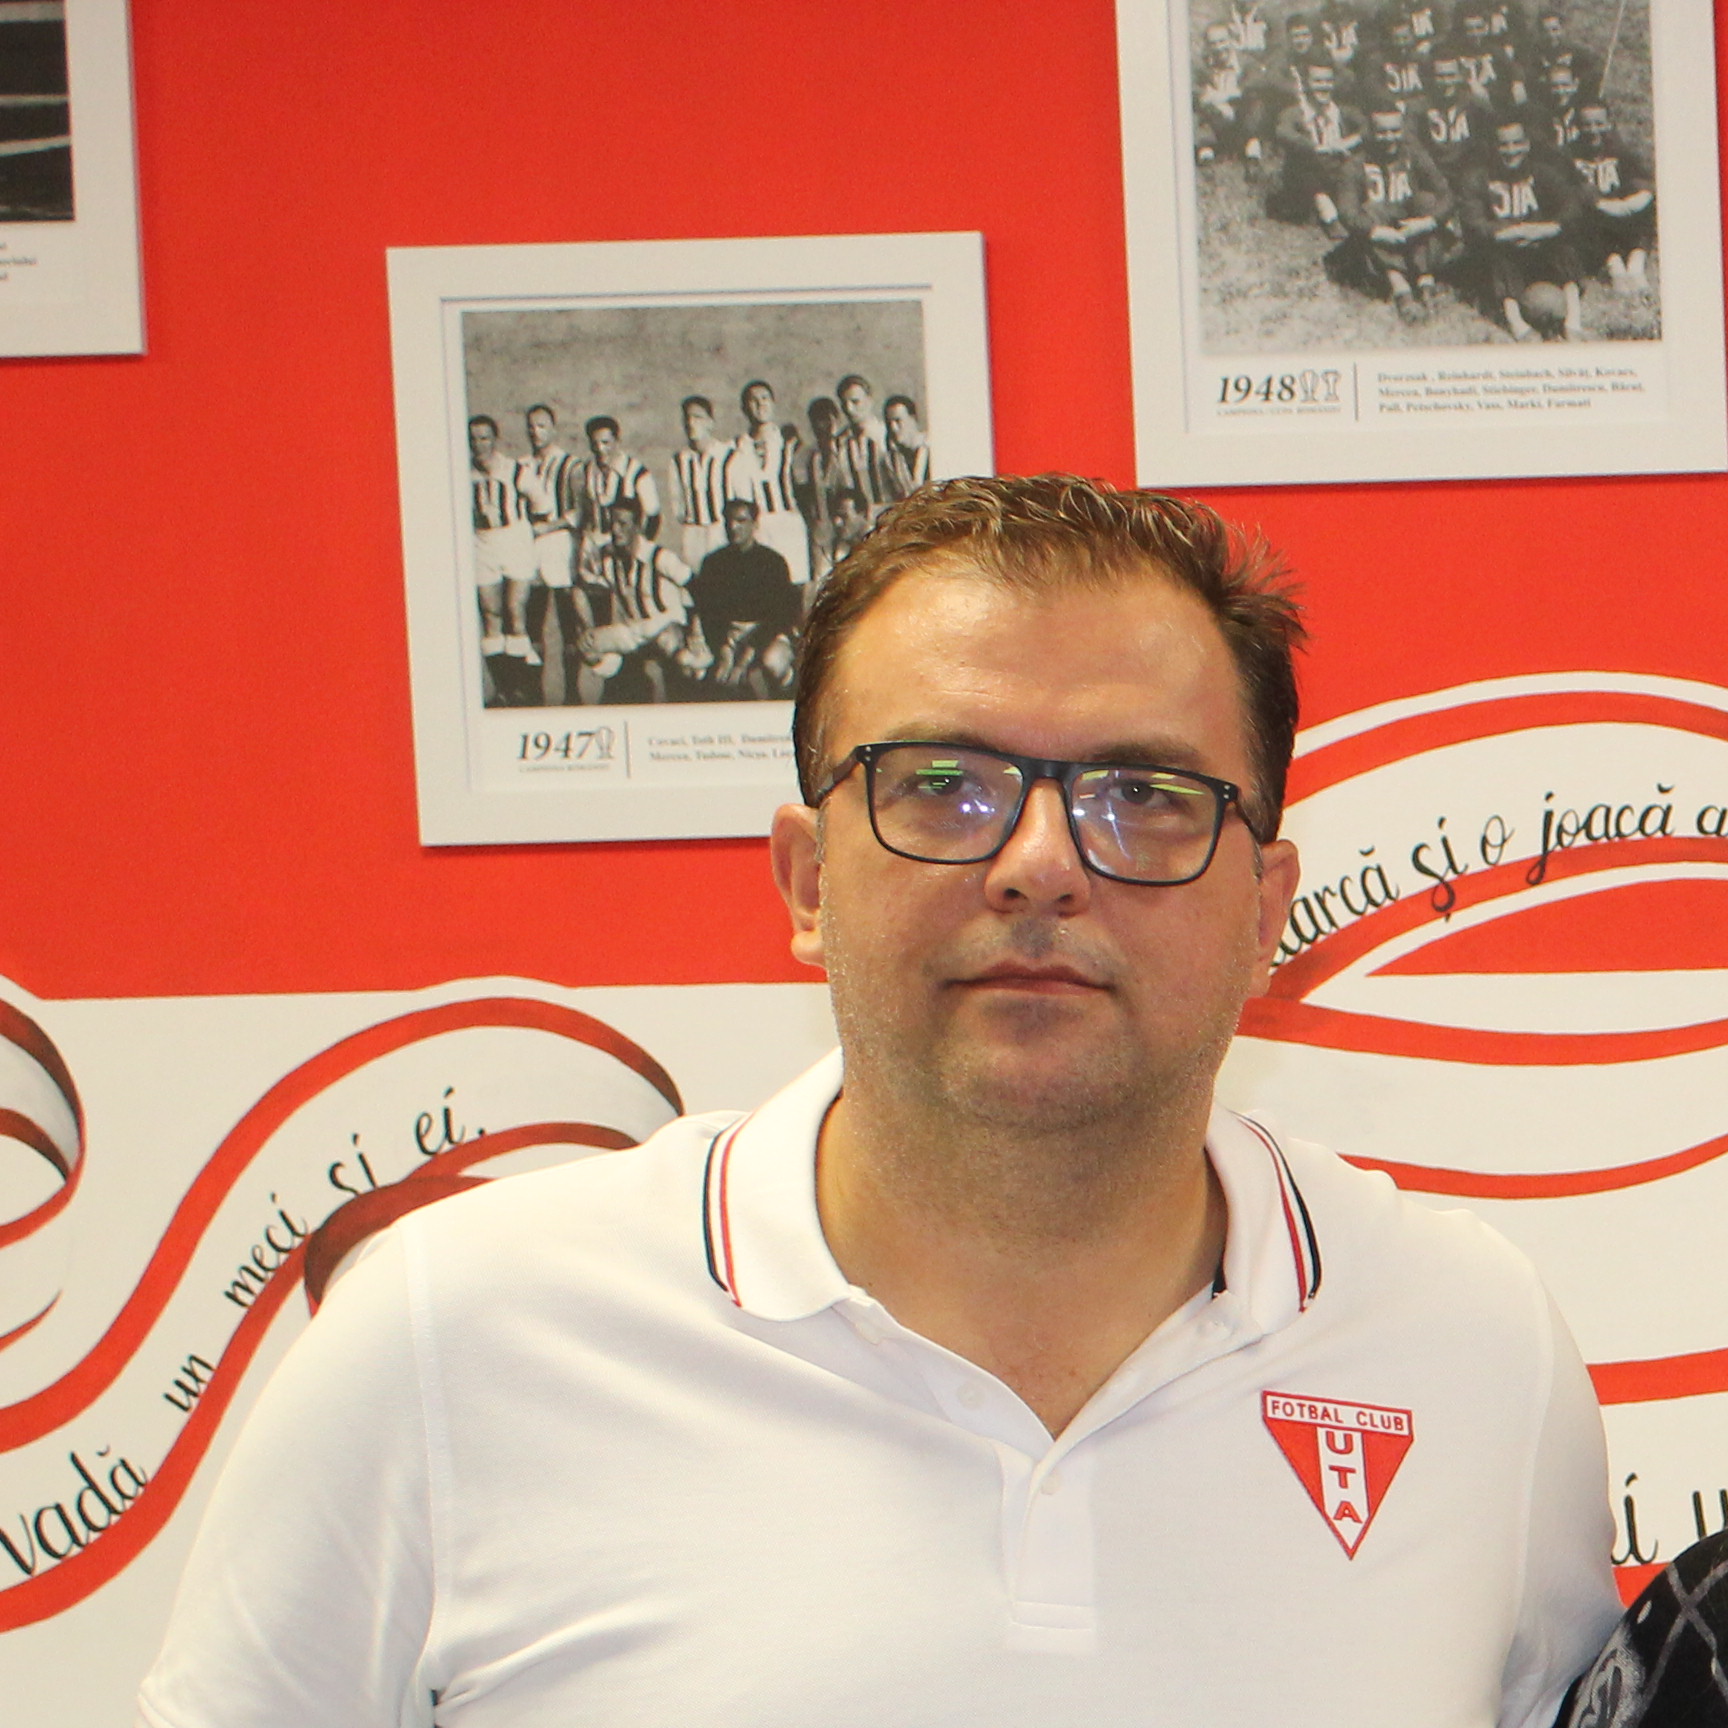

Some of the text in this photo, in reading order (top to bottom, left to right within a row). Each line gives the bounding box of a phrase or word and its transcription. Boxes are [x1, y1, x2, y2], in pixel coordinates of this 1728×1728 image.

[1217, 374, 1296, 403] 1948
[517, 731, 596, 760] 1947
[1480, 815, 1515, 866] o
[1526, 783, 1675, 886] joacă
[163, 1354, 217, 1412] un
[223, 1192, 309, 1309] meci
[1270, 1399, 1405, 1432] FOTBAL CLUB
